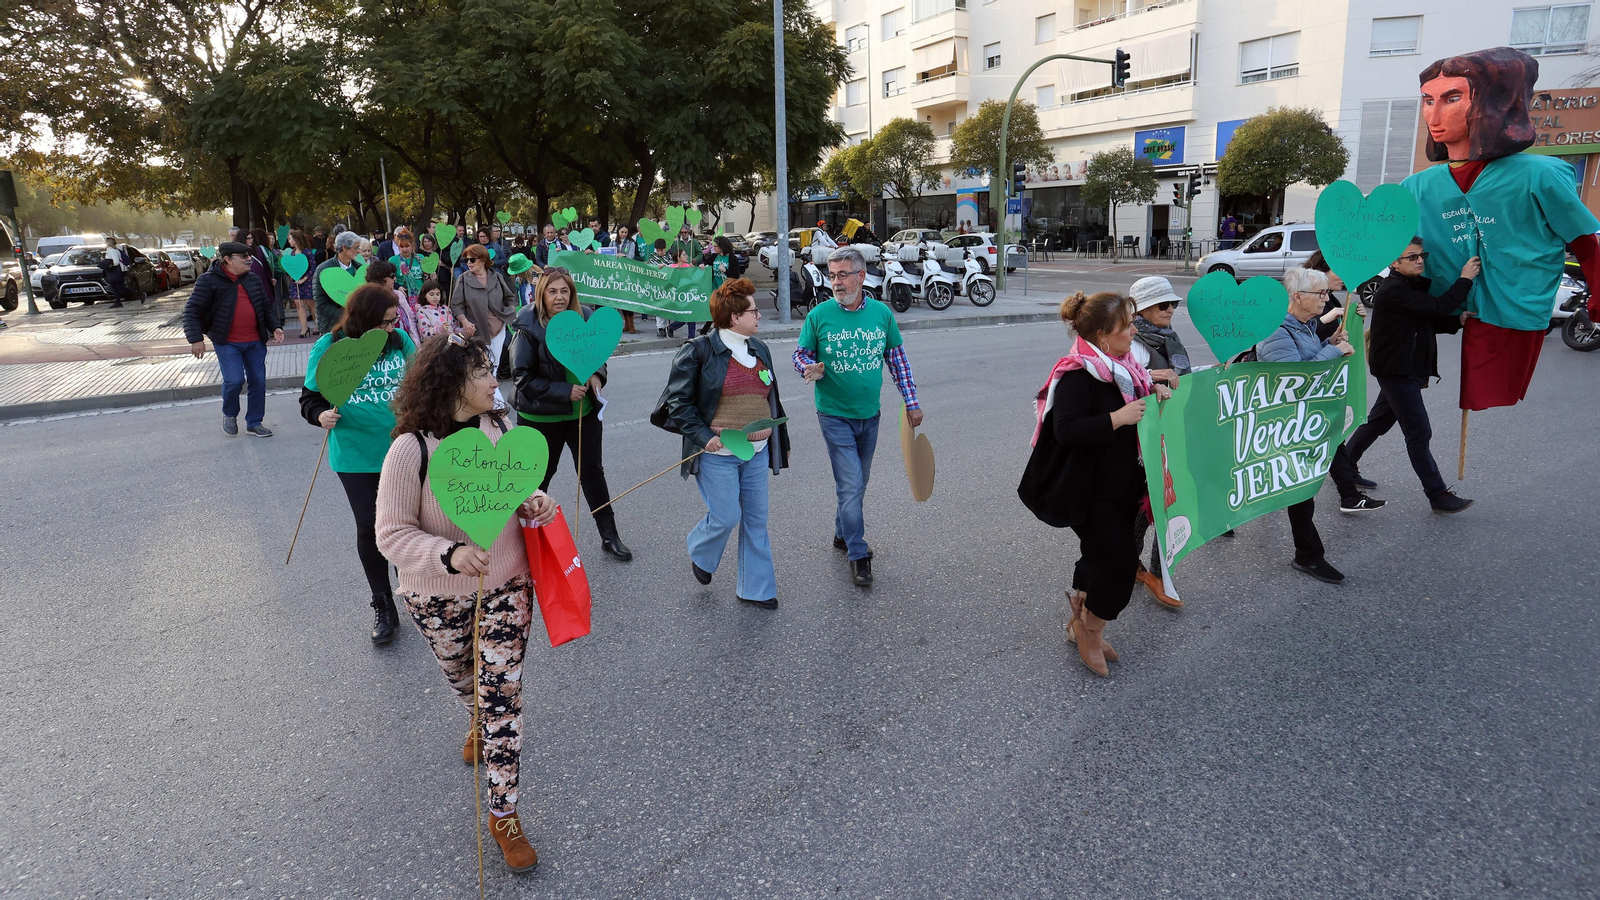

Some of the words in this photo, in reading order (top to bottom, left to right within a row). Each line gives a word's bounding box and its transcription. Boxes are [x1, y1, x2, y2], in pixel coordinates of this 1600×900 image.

[1535, 131, 1600, 146] FLORES
[1156, 144, 1176, 153] BRASIL
[1442, 207, 1471, 219] ESCUELA
[1453, 222, 1466, 231] DE
[593, 258, 622, 270] MAREA
[623, 264, 645, 276] VERDE
[645, 269, 667, 280] JEREZ
[613, 281, 624, 291] DE
[827, 330, 862, 342] ESCUELA
[836, 350, 848, 358] DE
[834, 362, 859, 372] PARA
[1217, 364, 1349, 421] MAREA
[1235, 400, 1328, 463] Verde
[445, 444, 538, 472] Rotonda:
[1229, 441, 1332, 507] JEREZ
[447, 471, 525, 493] Escuela
[453, 494, 515, 515] Pública
